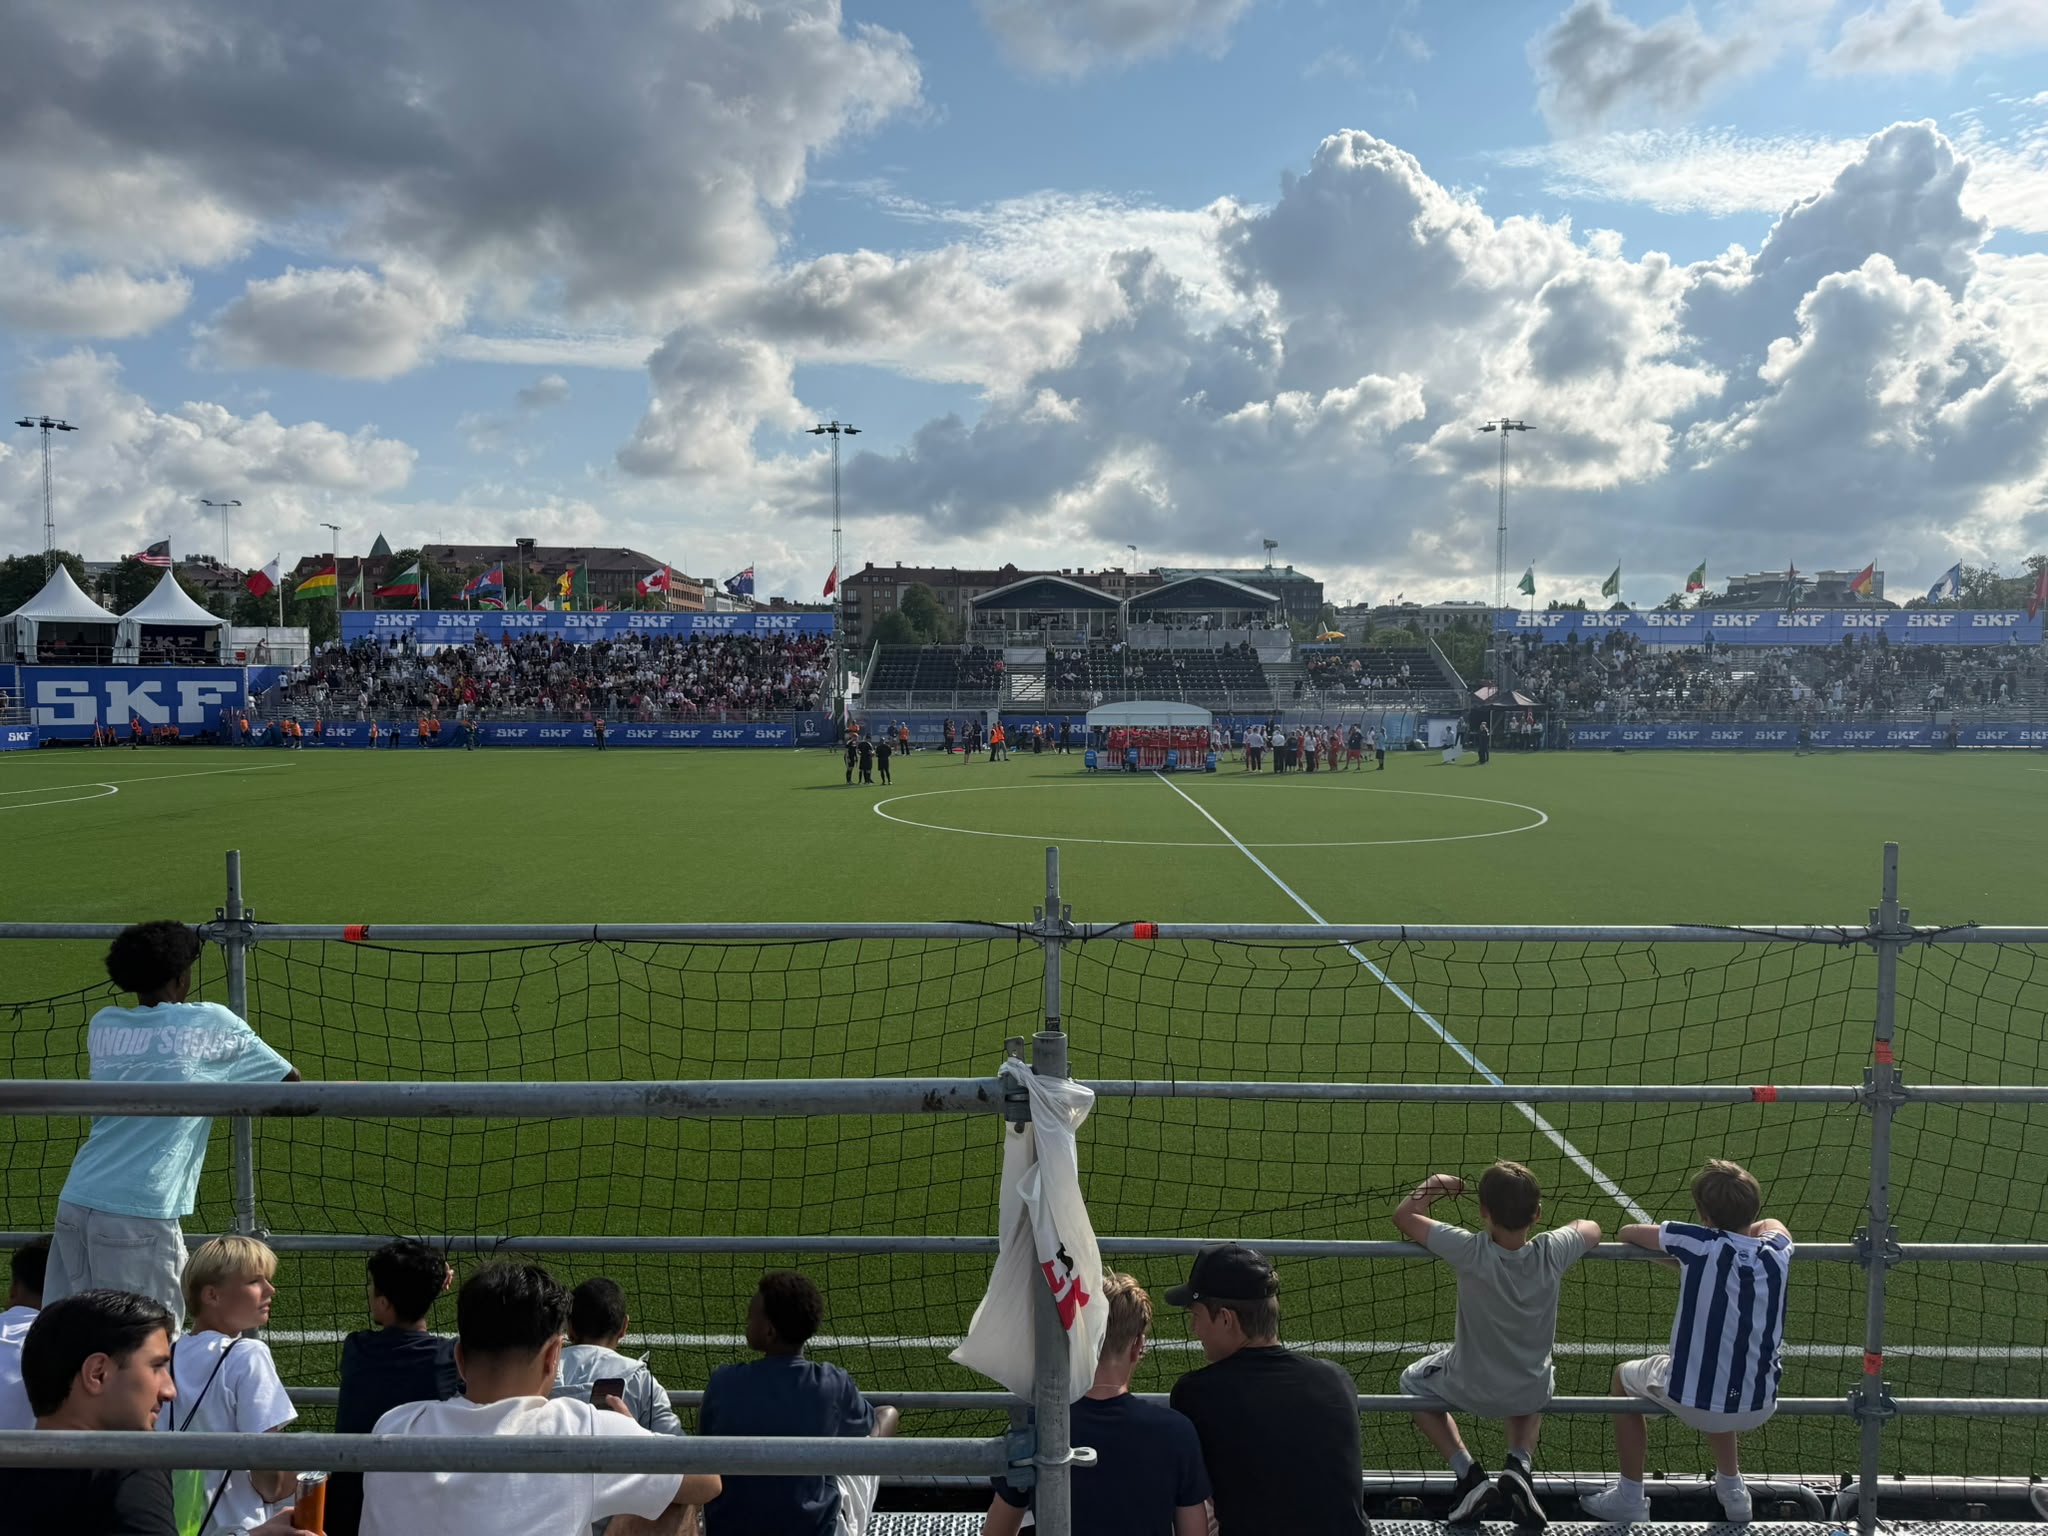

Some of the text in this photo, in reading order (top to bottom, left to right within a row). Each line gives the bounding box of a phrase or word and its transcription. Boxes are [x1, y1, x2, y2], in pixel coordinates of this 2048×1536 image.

[375, 615, 421, 627] SKF
[438, 615, 484, 627] SKF
[501, 615, 547, 627] SKF
[565, 615, 611, 627] SKF
[629, 615, 674, 627] SKF
[692, 615, 738, 627] SKF
[755, 615, 800, 627] SKF
[1516, 614, 1564, 627] SKF
[1582, 614, 1630, 627] SKF
[1648, 614, 1695, 627] SKF
[1712, 614, 1760, 627] SKF
[1777, 614, 1824, 627] SKF
[1842, 614, 1889, 627] SKF
[1907, 614, 1954, 627] SKF
[1972, 614, 2020, 627] SKF
[31, 681, 237, 725] SKF
[8, 732, 32, 742] SKF
[325, 728, 356, 737] SKF
[497, 728, 528, 738] SKF
[540, 728, 571, 738] SKF
[627, 729, 658, 738] SKF
[670, 730, 701, 739] SKF
[712, 730, 744, 738] SKF
[755, 730, 787, 738] SKF
[1578, 731, 1611, 740] SKF
[1623, 731, 1655, 740] SKF
[1667, 731, 1699, 740] SKF
[1711, 731, 1743, 740] SKF
[1755, 731, 1787, 740] SKF
[1810, 731, 1831, 740] KF
[1843, 731, 1875, 740] SKF
[1887, 731, 1919, 740] SKF
[1976, 731, 2008, 740] SKF
